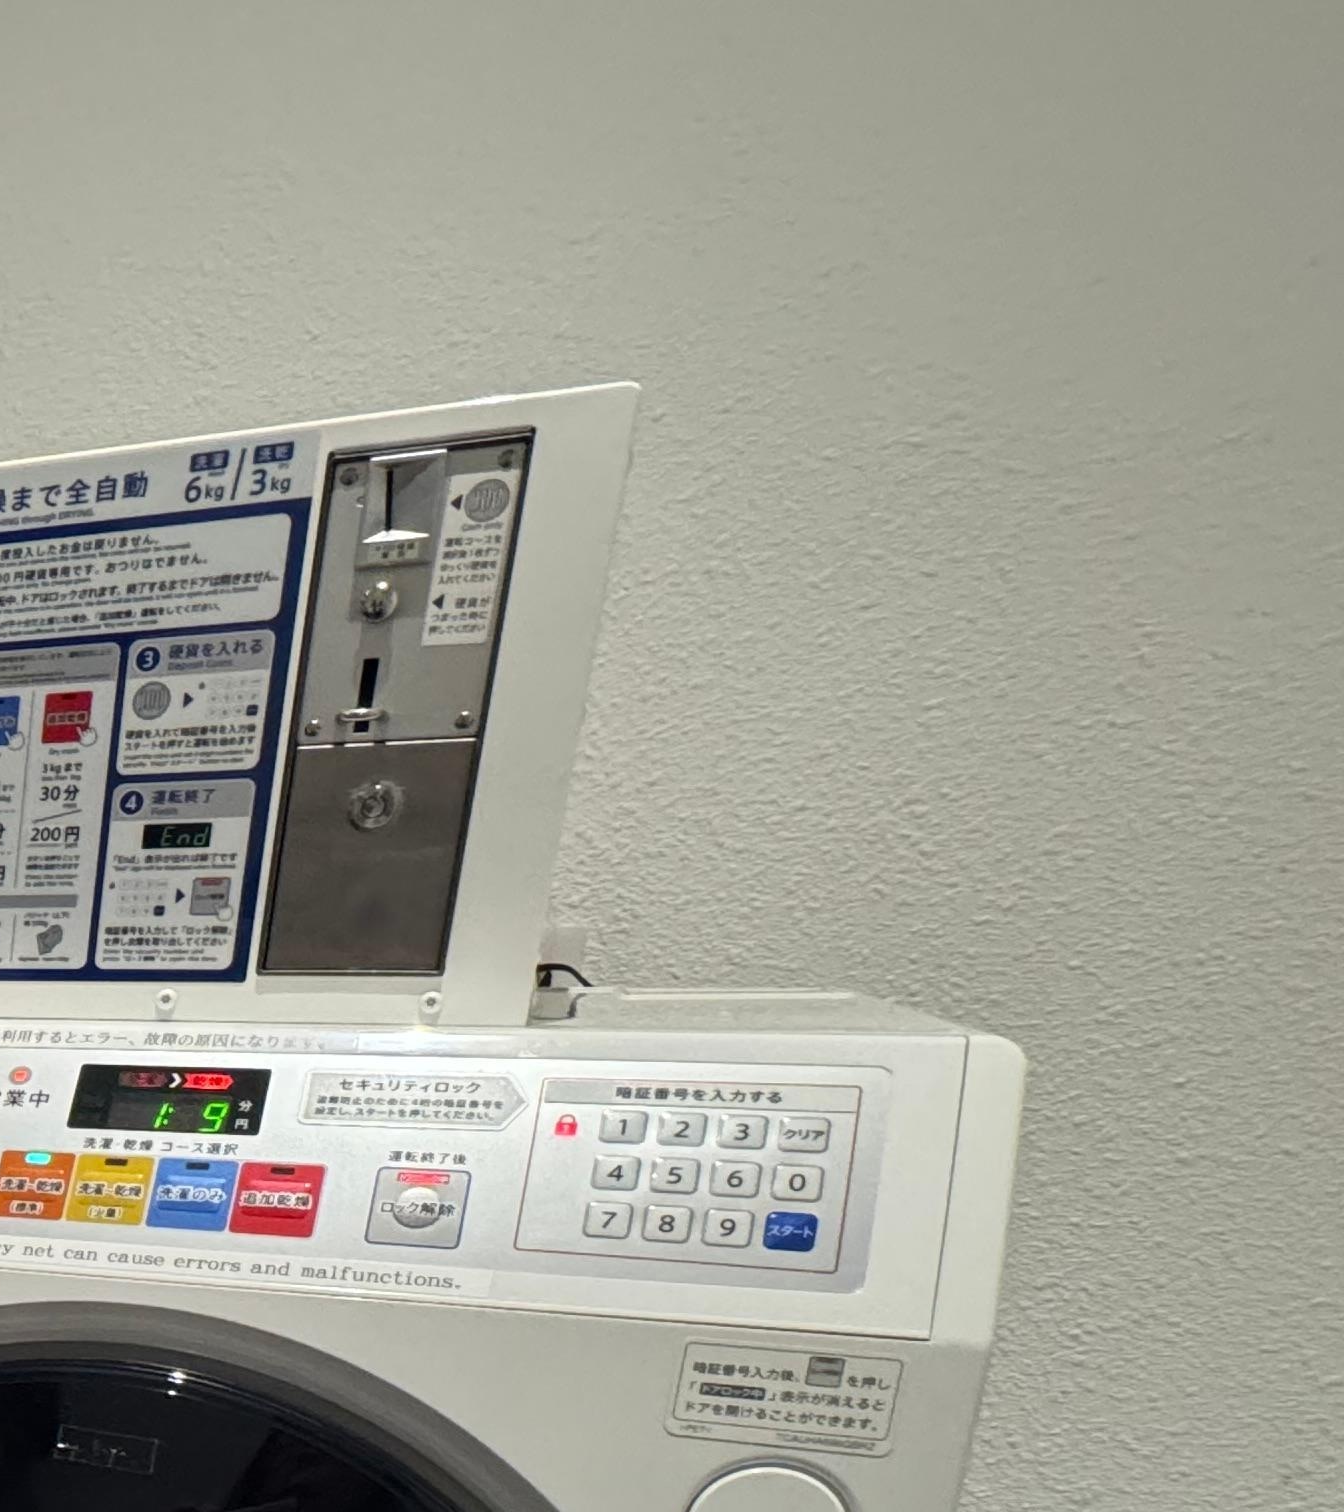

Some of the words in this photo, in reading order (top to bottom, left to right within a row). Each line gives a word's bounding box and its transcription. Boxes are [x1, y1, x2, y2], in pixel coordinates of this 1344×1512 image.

[169, 639, 263, 659] 硬貨を入れる
[30, 826, 80, 843] 200円
[160, 824, 210, 848] End
[339, 1078, 481, 1094] セキュリティロック
[615, 1086, 783, 1104] 暗証番号を入力する
[675, 1121, 689, 1138] 2
[734, 1123, 749, 1141] 3
[782, 1128, 826, 1142] クリア
[161, 1141, 239, 1155] コース選択
[388, 1150, 467, 1165] 運転終了後
[607, 1164, 624, 1182] 4
[667, 1166, 682, 1184] 5
[727, 1170, 743, 1188] 6
[789, 1173, 806, 1191] 0
[159, 1186, 225, 1201] 洗濯のみ
[241, 1192, 310, 1208] 追加乾燥
[380, 1201, 456, 1217] ロック解除
[601, 1211, 618, 1229] 7
[659, 1214, 675, 1233] 8
[721, 1218, 737, 1237] 9
[767, 1222, 814, 1239] スタート
[23, 1242, 56, 1259] net
[64, 1248, 98, 1262] can
[107, 1252, 165, 1267] cause
[173, 1257, 241, 1272] errors
[250, 1260, 289, 1276] and
[301, 1263, 462, 1290] malfunctions.
[684, 1402, 878, 1432] ドアを開けることができます。
